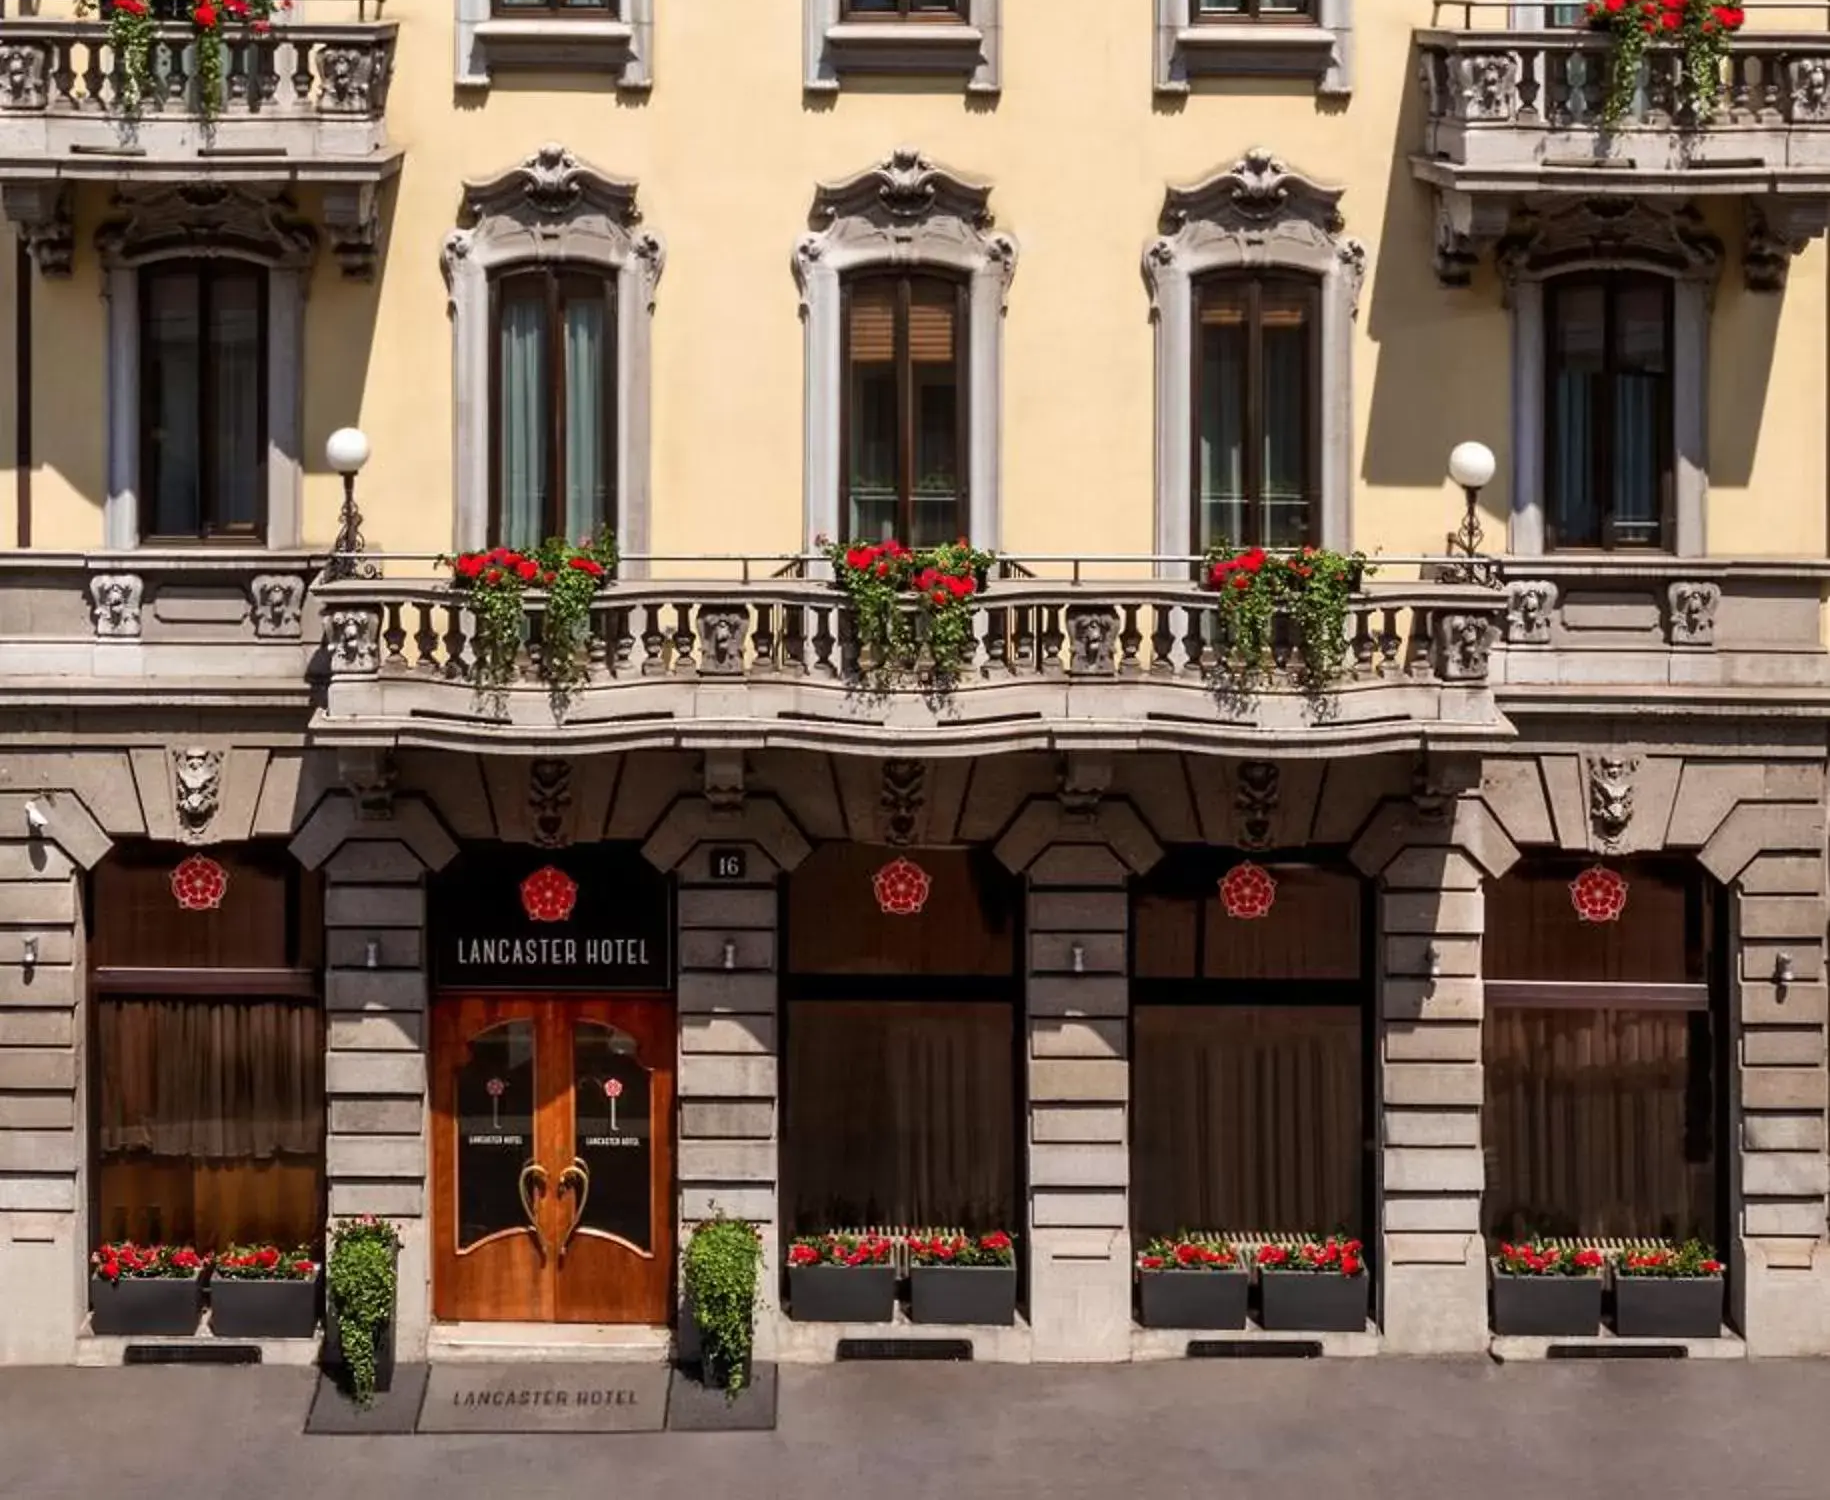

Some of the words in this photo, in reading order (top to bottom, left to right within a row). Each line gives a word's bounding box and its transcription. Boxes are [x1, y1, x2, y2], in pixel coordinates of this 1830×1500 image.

[719, 856, 739, 876] 16
[457, 938, 577, 965] LANCASTER
[586, 938, 650, 965] HOTEL
[453, 1389, 568, 1408] LANCASTER
[576, 1389, 640, 1408] HOTEL
